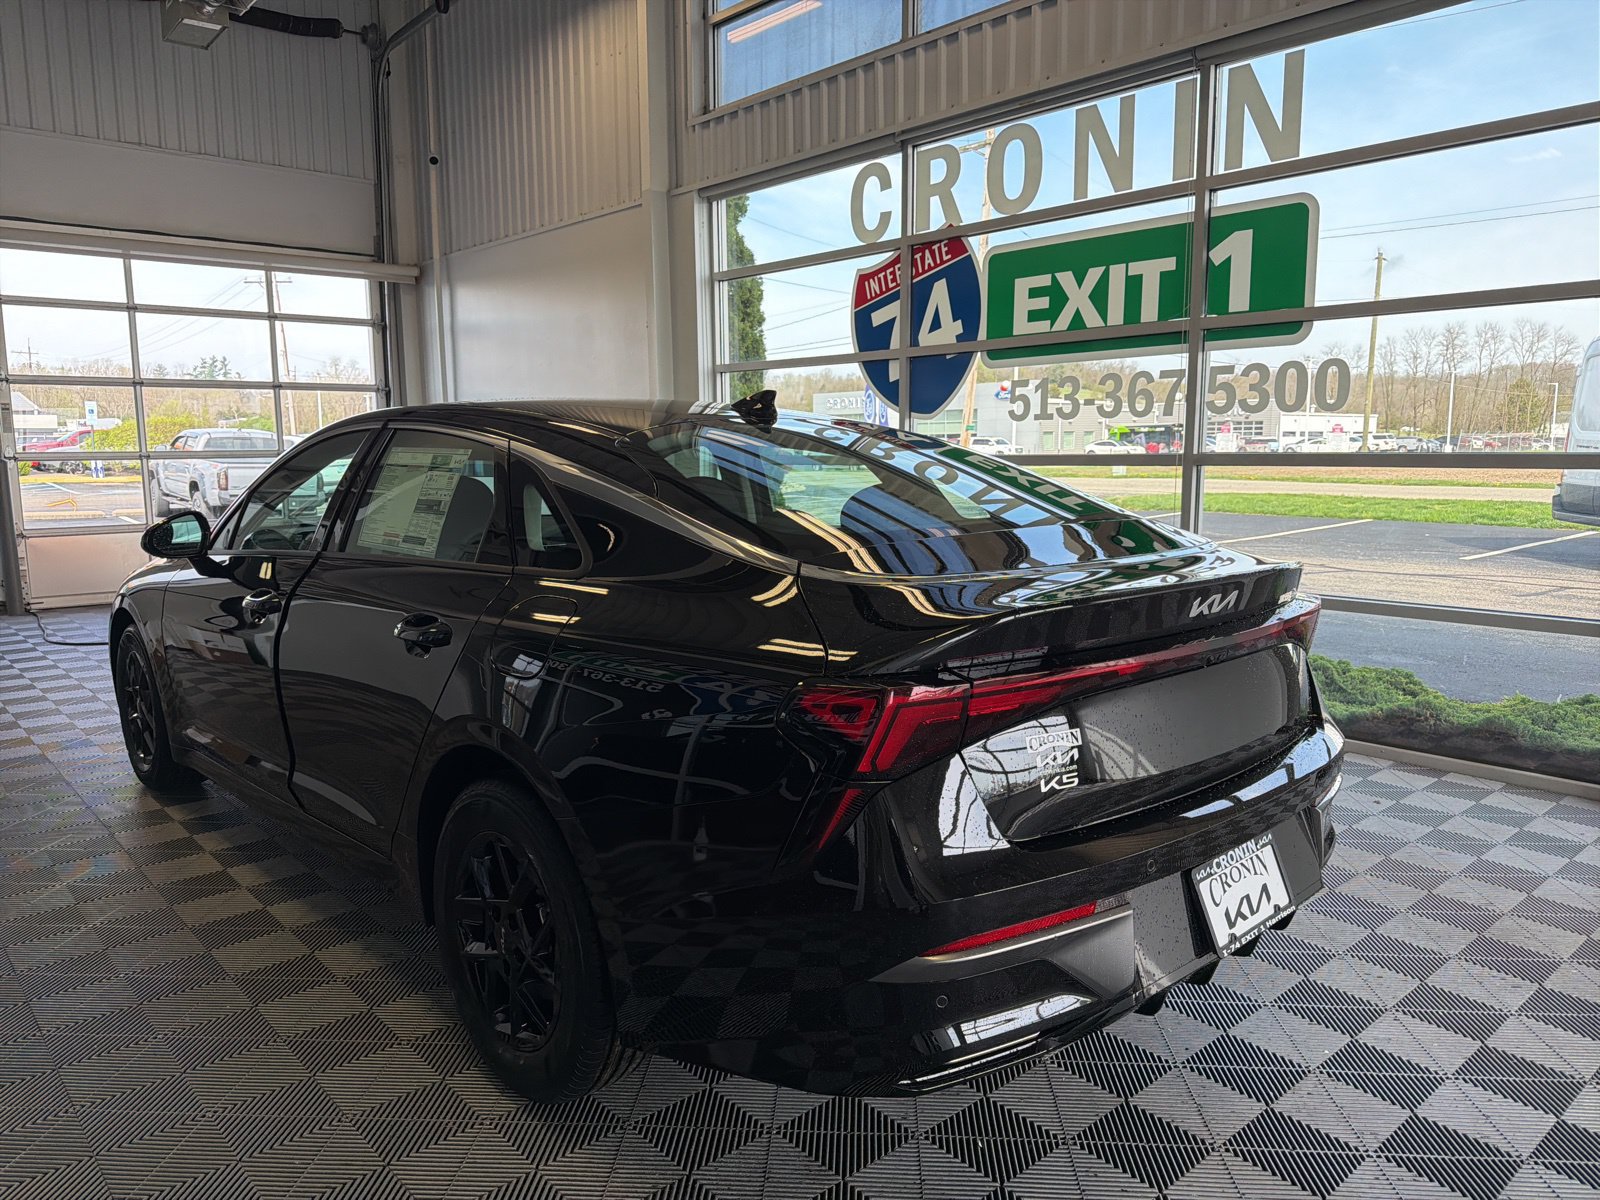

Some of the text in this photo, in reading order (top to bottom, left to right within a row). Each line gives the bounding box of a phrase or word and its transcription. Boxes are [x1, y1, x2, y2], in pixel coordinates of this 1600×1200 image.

[850, 49, 1306, 245] CRONIN
[864, 240, 952, 300] INTETATE
[1013, 229, 1254, 336] EXIT 1
[870, 277, 964, 383] 74
[1188, 590, 1239, 618] KIA
[1028, 730, 1081, 752] CRONIN
[1036, 748, 1080, 768] KIA
[1040, 772, 1079, 793] K5
[1208, 851, 1271, 908] CRONIN
[1212, 839, 1258, 874] CRONIN
[1222, 942, 1241, 958] I-74
[1241, 930, 1260, 946] EXIT
[1265, 905, 1296, 928] Harrison
[1224, 883, 1272, 931] KIA
